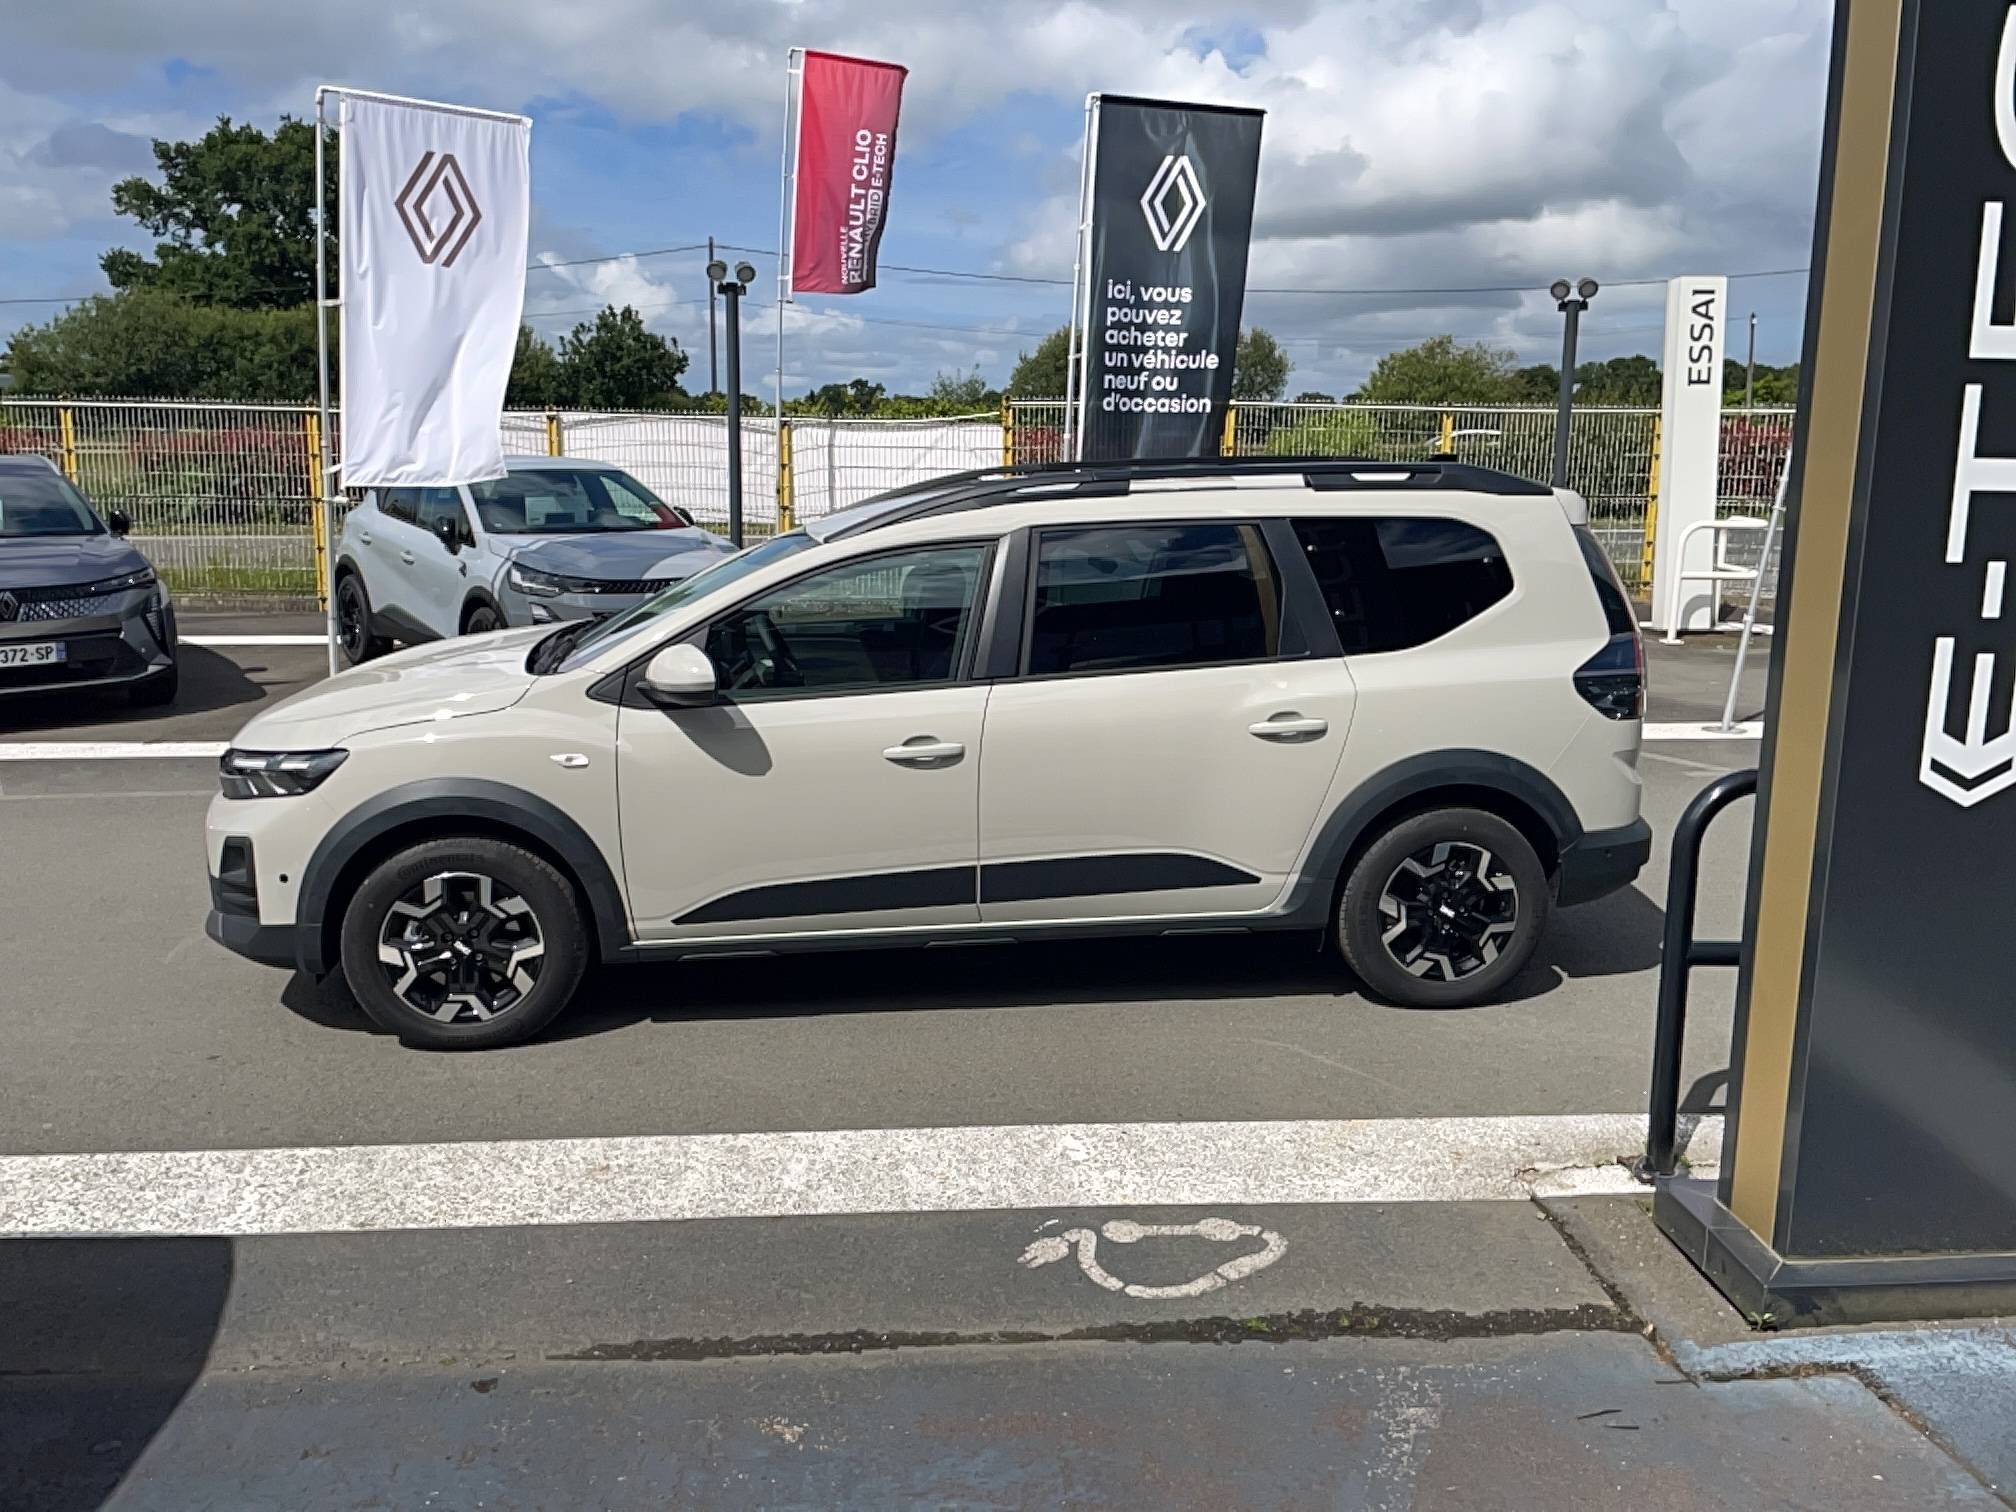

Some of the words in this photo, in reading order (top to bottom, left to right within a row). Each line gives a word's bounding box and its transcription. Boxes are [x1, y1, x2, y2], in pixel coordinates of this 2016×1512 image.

[852, 129, 872, 181] CLIO
[871, 133, 887, 187] E-TECH
[848, 183, 866, 284] RENAULT
[840, 226, 849, 285] NOUVELLE
[1106, 279, 1135, 305] ici,
[1140, 286, 1193, 304] vous
[1106, 306, 1182, 326] pouvez
[1104, 326, 1189, 348] acheter
[1687, 289, 1716, 387] ESSAI
[1104, 351, 1128, 368] un
[1131, 349, 1219, 370] véhicule
[1103, 372, 1149, 390] neuf
[1151, 376, 1179, 391] ou
[1102, 391, 1212, 414] d'occasion
